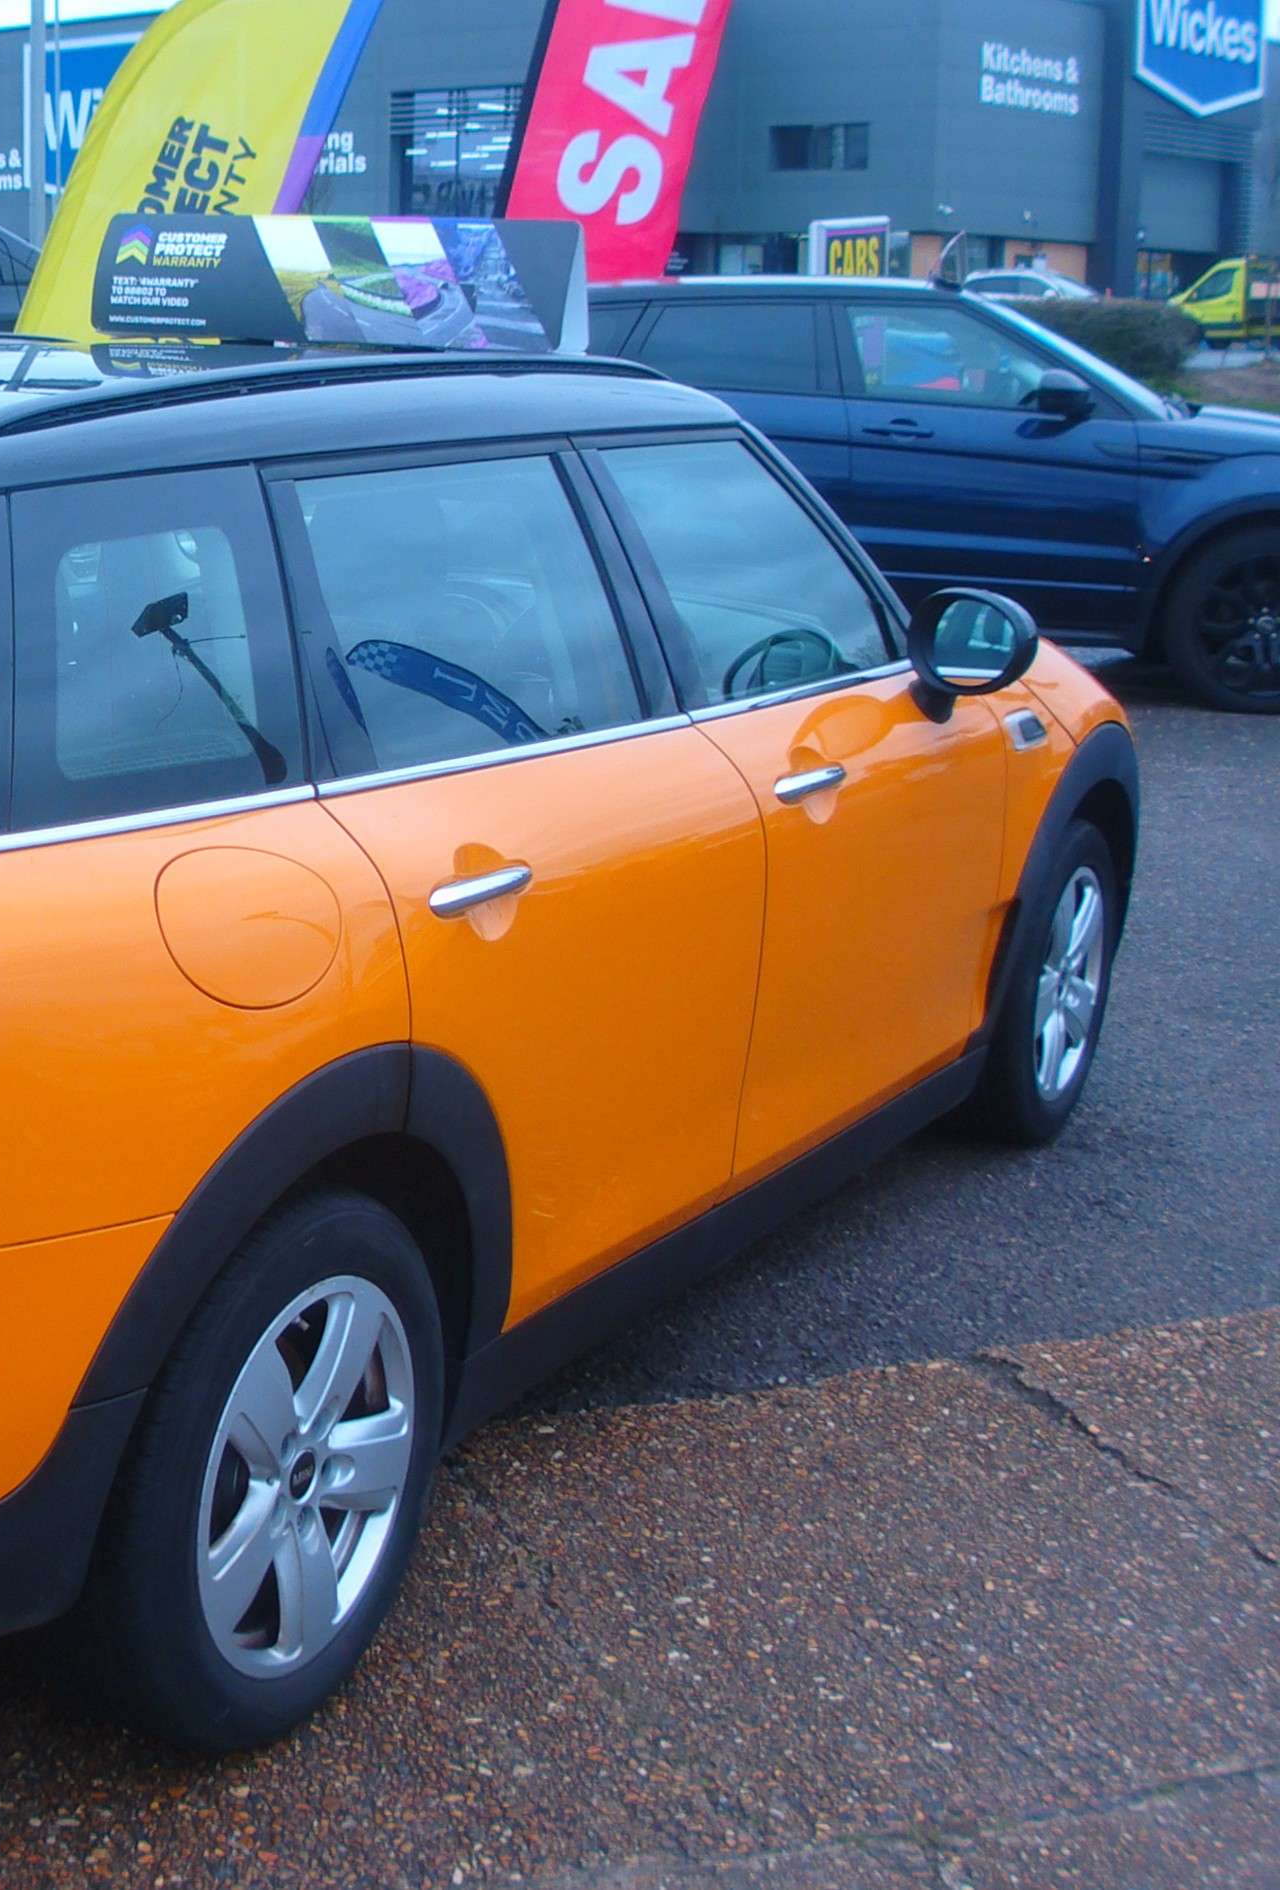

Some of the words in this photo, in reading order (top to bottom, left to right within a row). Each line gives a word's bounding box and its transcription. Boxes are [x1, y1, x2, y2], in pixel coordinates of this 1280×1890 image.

[1149, 0, 1258, 64] Wickes
[982, 41, 1064, 82] Kitchens
[1065, 57, 1079, 84] &
[980, 74, 1080, 117] Bathrooms
[324, 130, 354, 153] ng
[8, 148, 23, 169] &
[315, 153, 367, 174] rials
[158, 231, 228, 245] CUSTOMER
[154, 243, 225, 257] PROTECT
[828, 236, 880, 276] CARS
[152, 256, 222, 269] WARRANTY
[110, 295, 140, 305] WATCH
[142, 296, 160, 306] OUR
[161, 297, 189, 307] VIDEO
[111, 286, 123, 295] TO
[154, 287, 167, 297] TO
